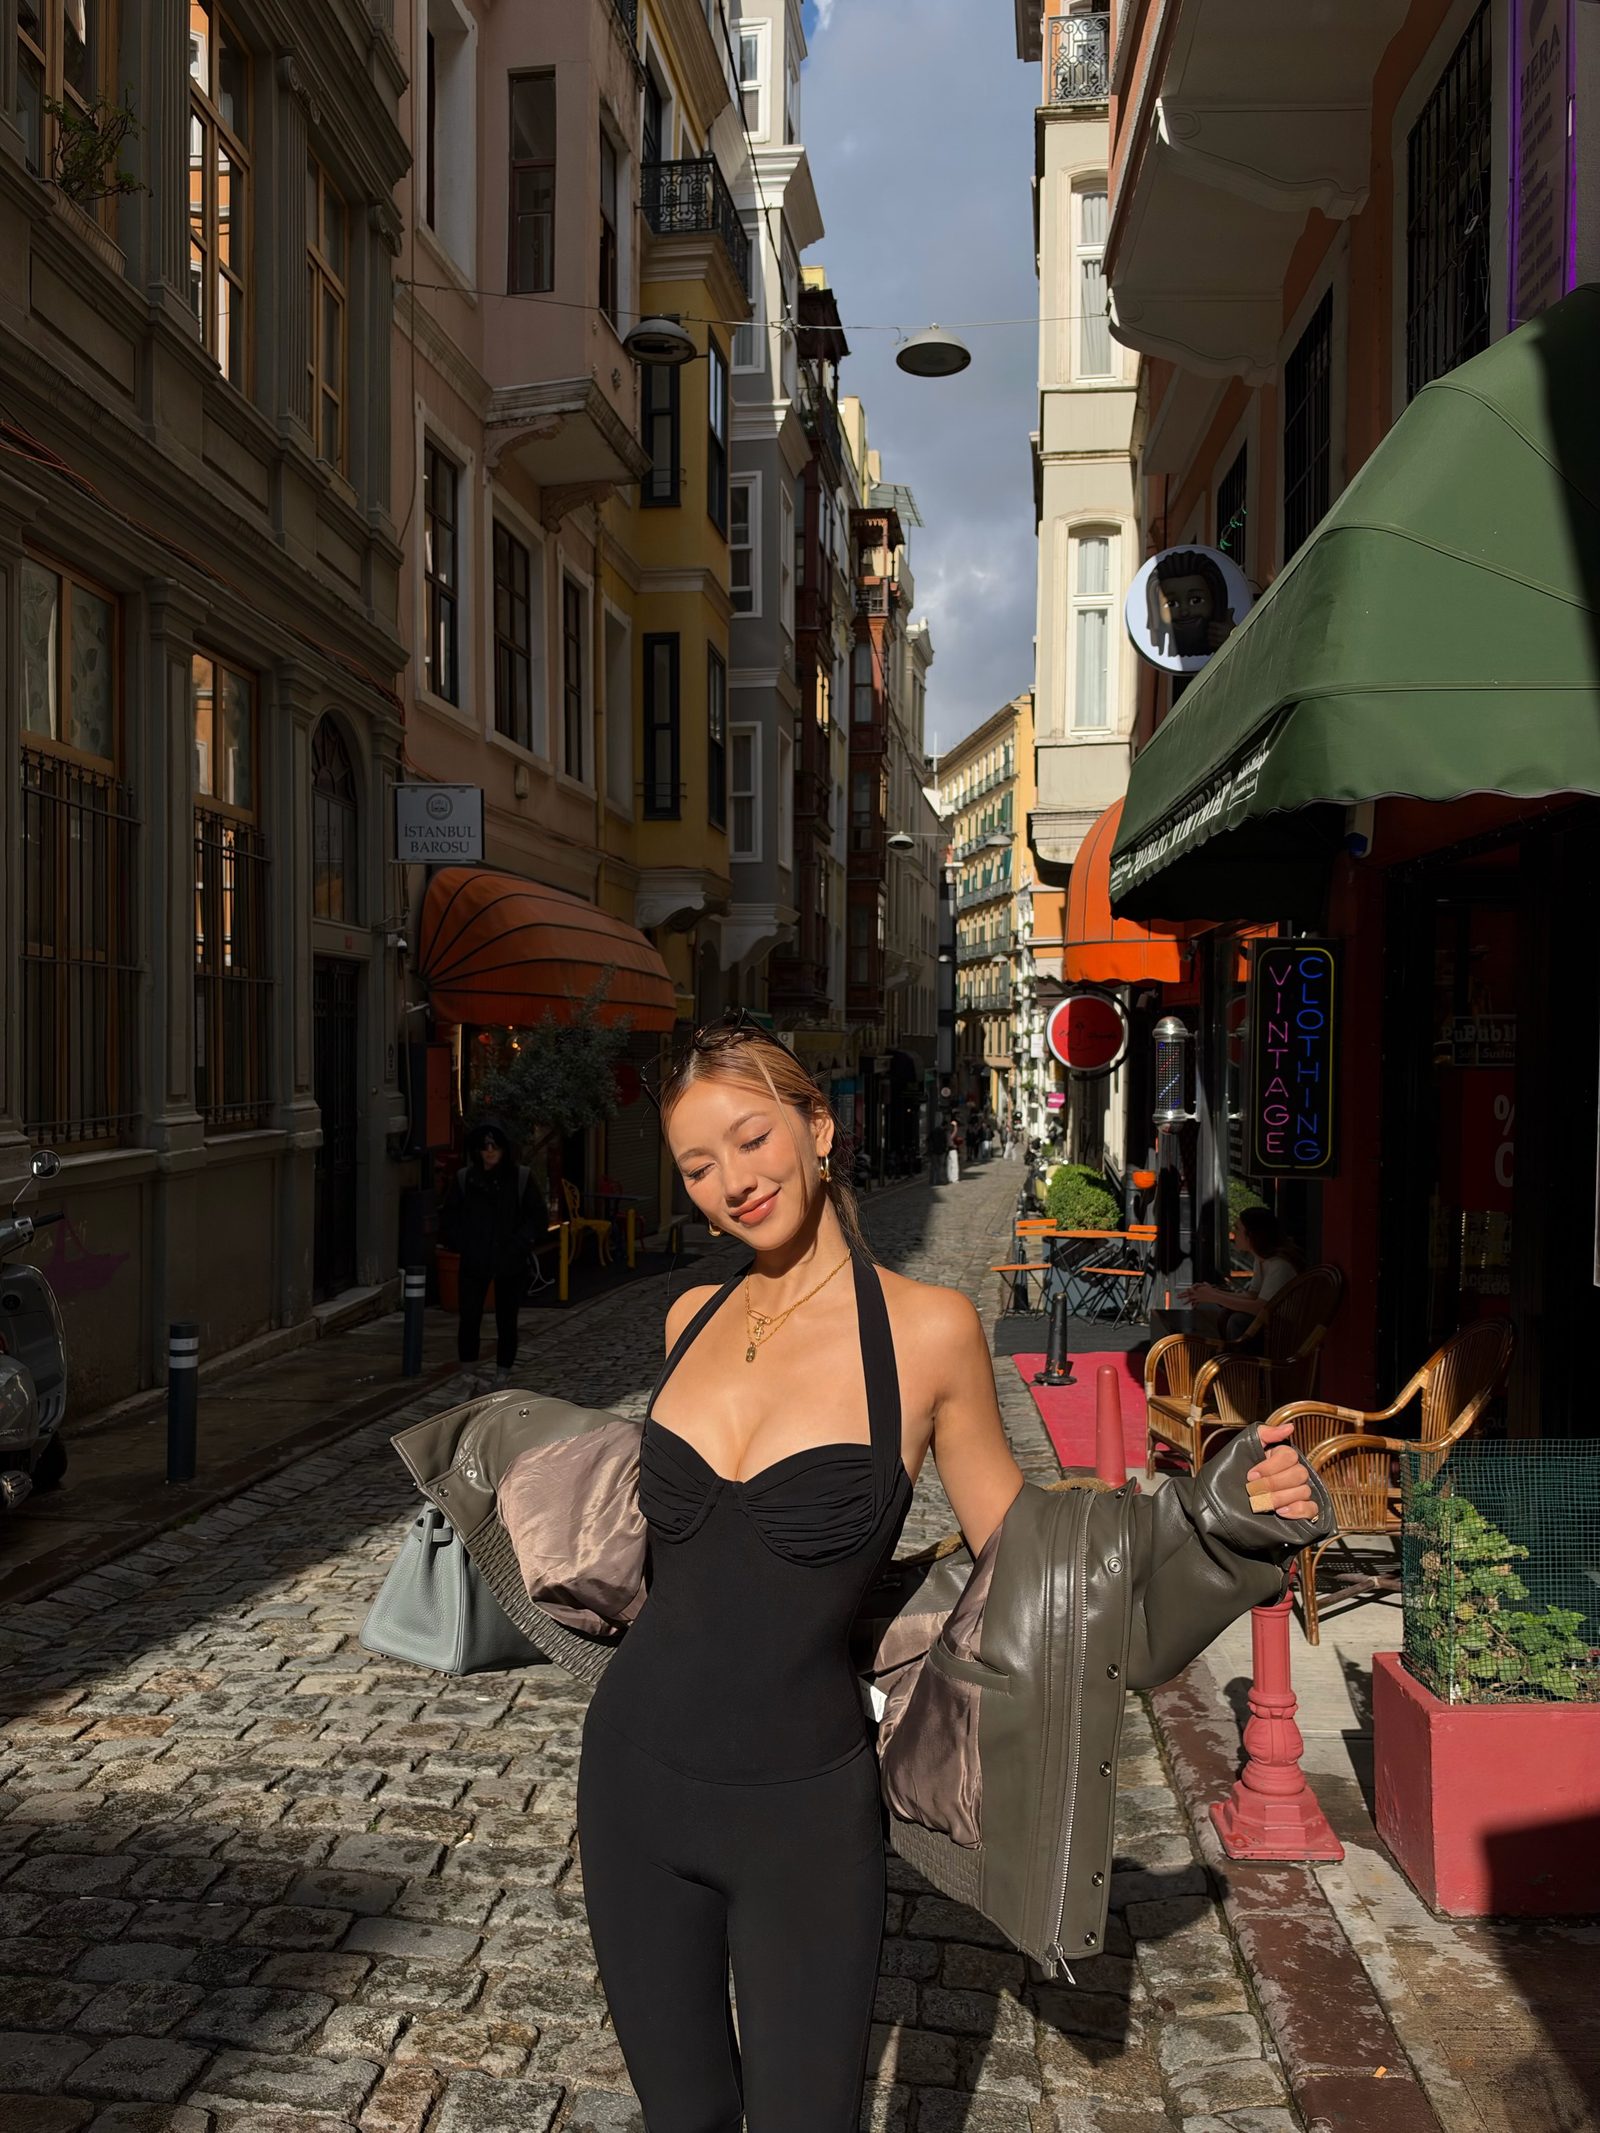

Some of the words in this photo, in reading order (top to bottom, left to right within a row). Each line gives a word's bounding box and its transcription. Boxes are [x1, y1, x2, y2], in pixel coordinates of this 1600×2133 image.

[1520, 24, 1560, 102] HERA
[404, 824, 476, 838] İSTANBUL
[410, 841, 470, 853] BAROSU
[1264, 965, 1292, 1153] VINTAGE
[1294, 956, 1324, 1161] CLOTHING
